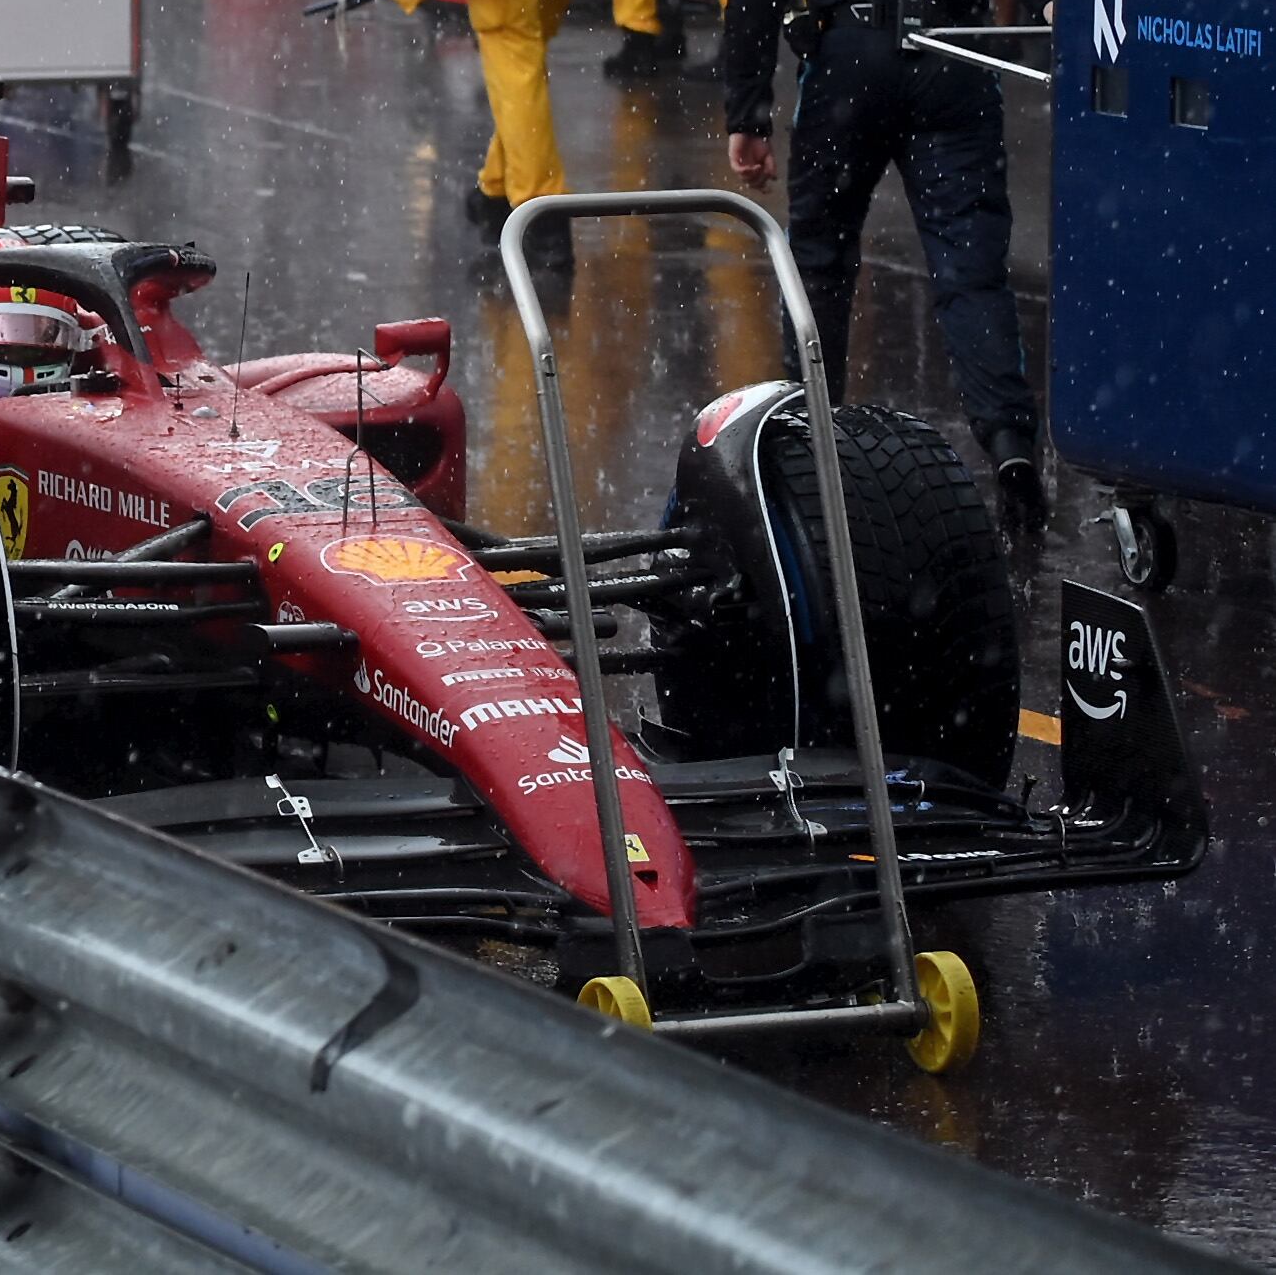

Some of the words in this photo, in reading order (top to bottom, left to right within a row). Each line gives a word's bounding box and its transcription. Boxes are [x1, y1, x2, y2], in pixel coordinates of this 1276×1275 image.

[1137, 15, 1213, 50] NICHOLAS
[1216, 25, 1262, 57] LATIFI
[38, 470, 112, 513] RICHARD
[118, 491, 170, 529] MILLE
[49, 601, 179, 612] #WeRaceAsOne
[402, 597, 488, 614] aws
[445, 637, 548, 654] Palantir
[1069, 621, 1126, 681] aws
[372, 668, 461, 749] Santander
[459, 698, 583, 732] MAHL
[517, 766, 654, 795] Santader
